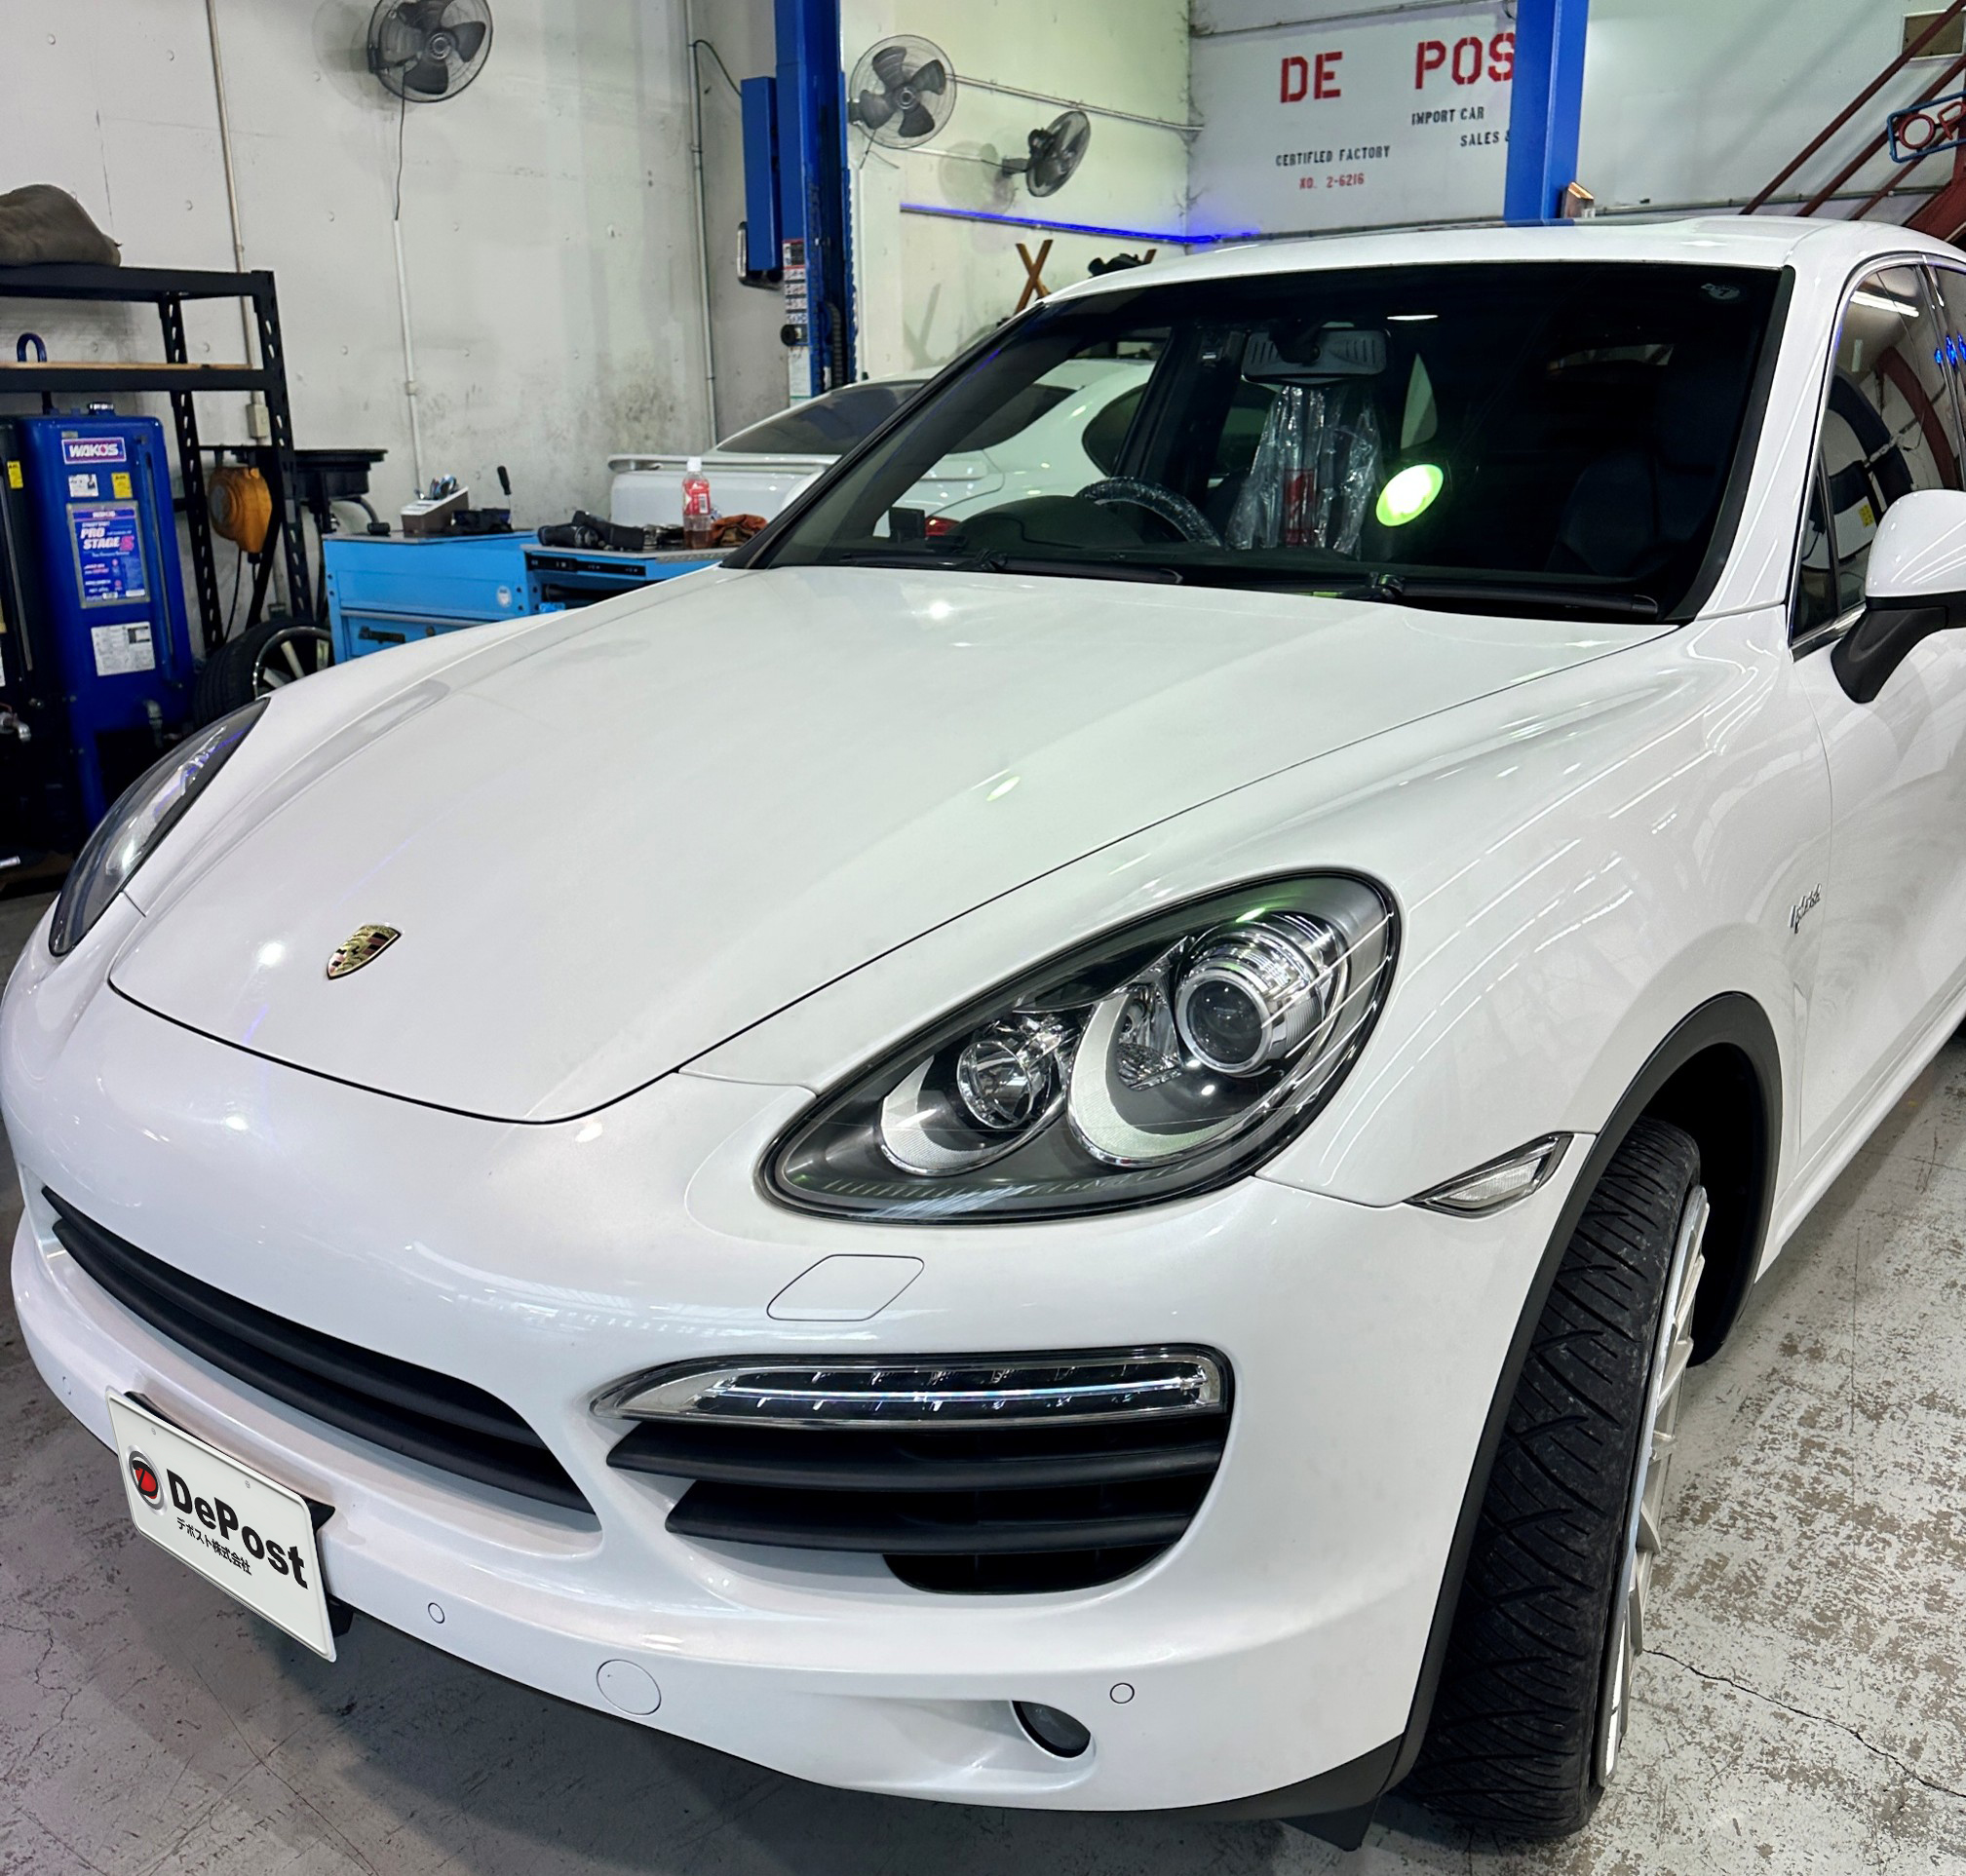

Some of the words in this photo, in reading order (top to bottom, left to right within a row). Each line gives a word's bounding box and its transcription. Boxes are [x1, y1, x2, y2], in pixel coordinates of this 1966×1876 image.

[1280, 51, 1343, 103] DE
[1411, 109, 1455, 125] IMPORT
[1460, 106, 1484, 120] CAR
[1460, 132, 1499, 147] SALES
[1338, 145, 1391, 162] FACTORY
[1326, 172, 1365, 188] 2-6216
[80, 527, 105, 539] PRO
[83, 537, 120, 550] STAGE
[166, 1468, 309, 1590] DePost
